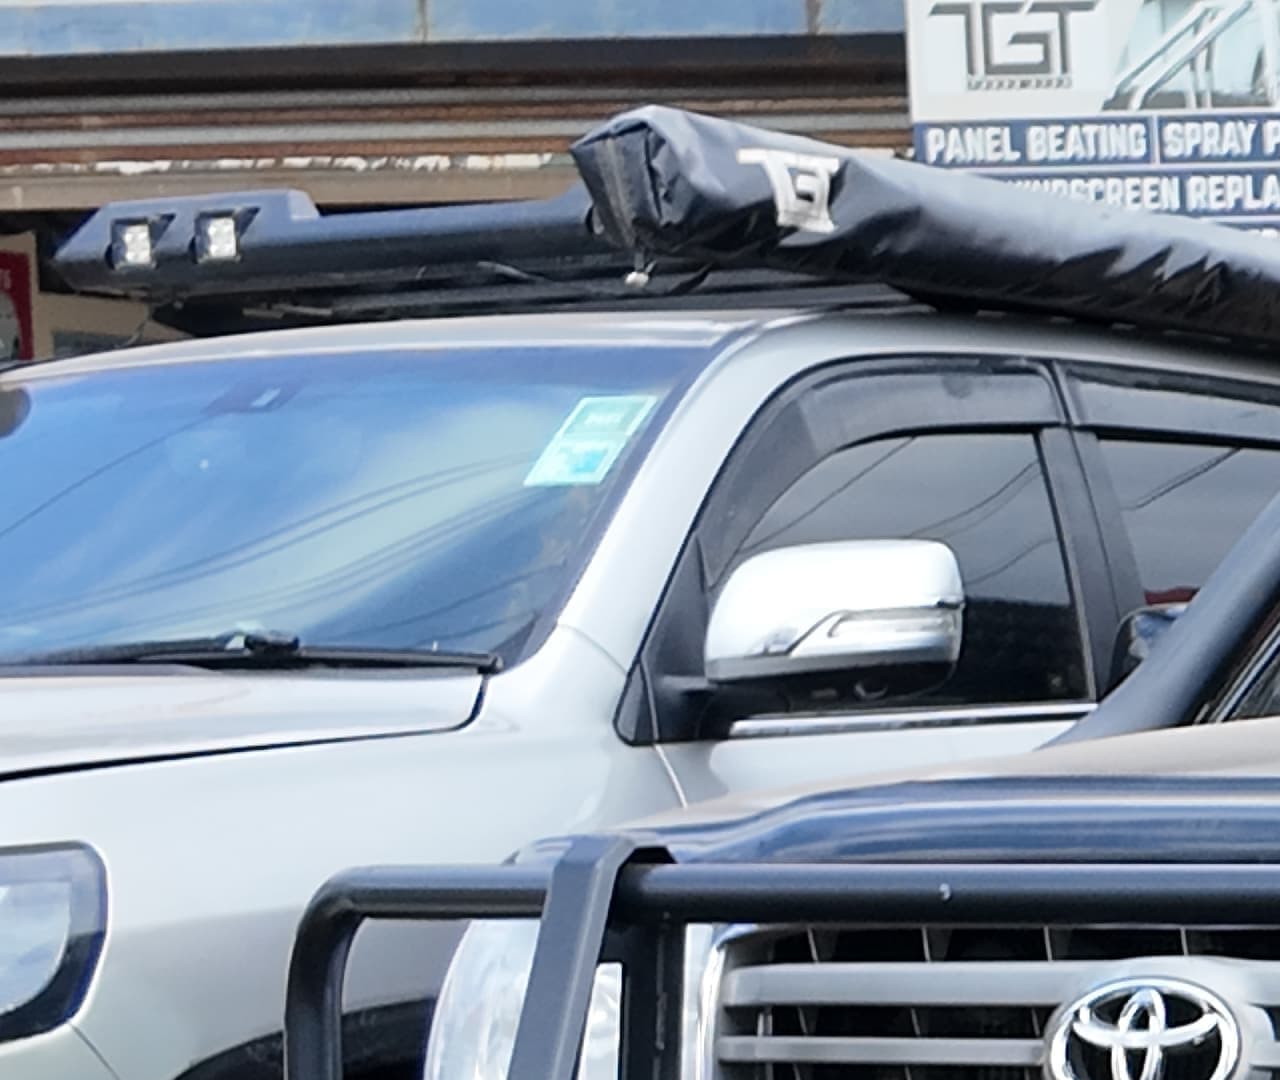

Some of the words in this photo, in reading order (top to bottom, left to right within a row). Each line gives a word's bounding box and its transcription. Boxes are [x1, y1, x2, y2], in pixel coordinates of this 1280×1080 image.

[928, 1, 1098, 75] TGT
[925, 126, 1021, 164] PANEL
[1026, 123, 1147, 161] BEATING
[1162, 120, 1257, 157] SPRAY
